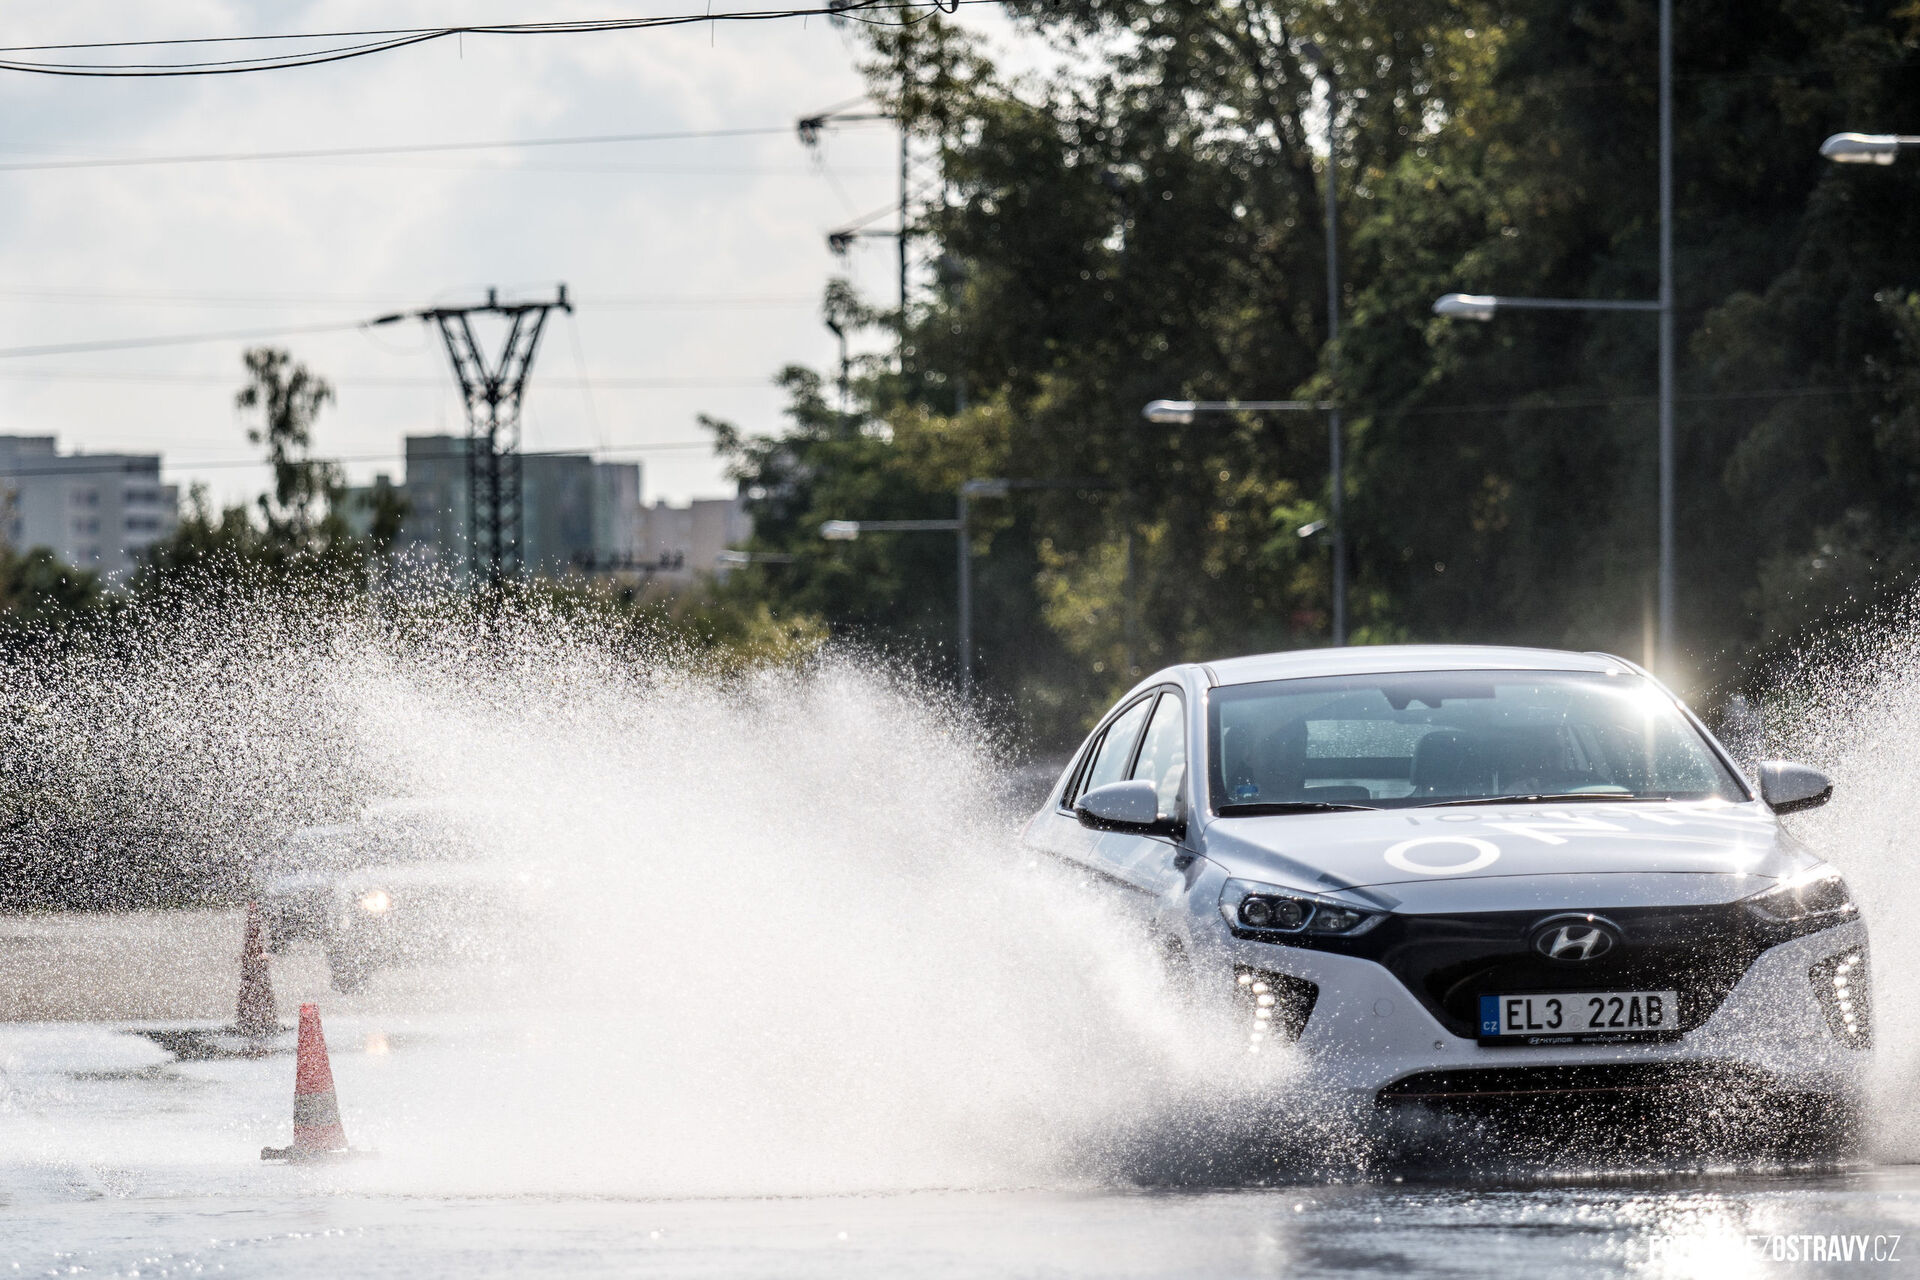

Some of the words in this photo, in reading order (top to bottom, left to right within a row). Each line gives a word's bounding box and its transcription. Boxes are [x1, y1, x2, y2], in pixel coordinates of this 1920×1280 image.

[1506, 998, 1563, 1031] EL3
[1588, 995, 1664, 1029] 22AB
[1482, 1021, 1498, 1033] CZ
